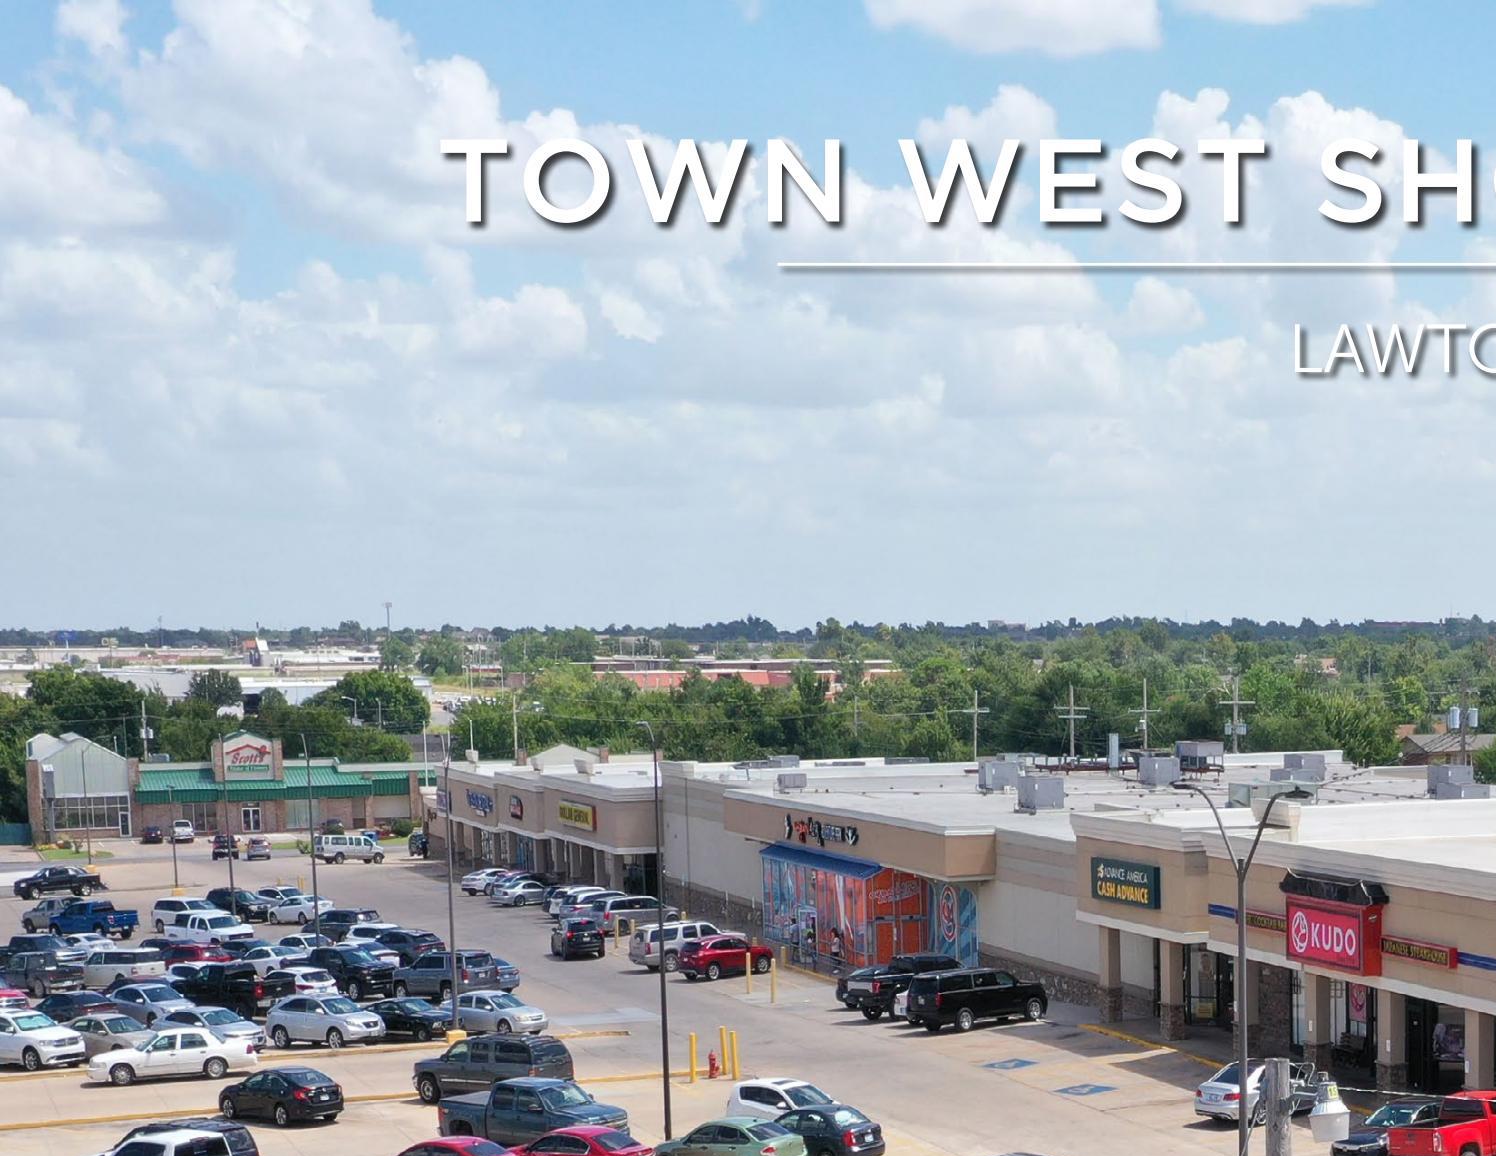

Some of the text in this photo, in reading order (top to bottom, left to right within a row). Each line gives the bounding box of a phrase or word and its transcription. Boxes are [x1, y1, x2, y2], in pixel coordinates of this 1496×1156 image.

[1104, 866, 1148, 883] ADVANCE AMERICA
[1096, 881, 1149, 904] CASH ADVANCE
[1310, 922, 1357, 956] KUDO
